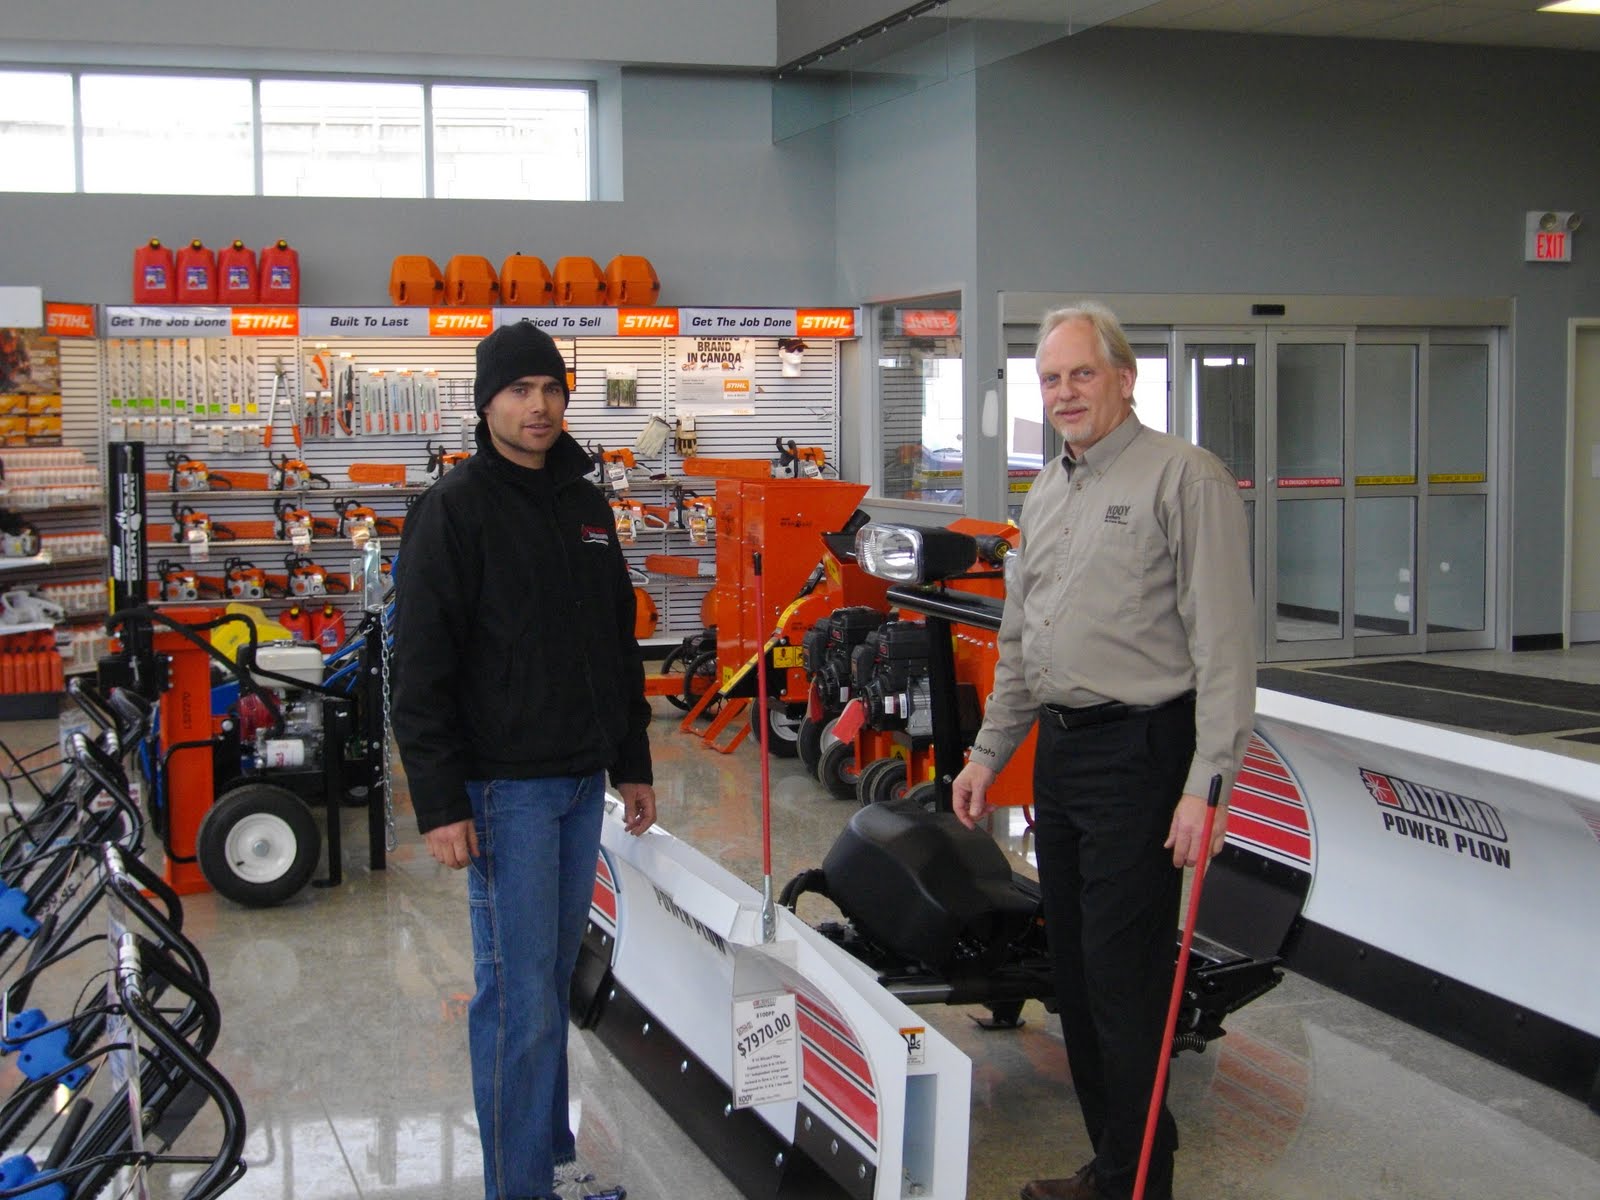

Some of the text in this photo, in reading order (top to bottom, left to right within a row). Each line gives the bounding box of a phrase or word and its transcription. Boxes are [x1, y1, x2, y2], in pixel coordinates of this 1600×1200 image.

[1537, 233, 1565, 259] EXIT
[48, 313, 90, 328] STIHL
[111, 316, 227, 327] Get The Job Done
[238, 314, 294, 329] STIHL
[330, 316, 409, 327] Built To Last
[435, 315, 488, 328] STIHL
[563, 317, 575, 327] To
[579, 317, 601, 327] Sell
[624, 315, 674, 328] STIHL
[692, 317, 792, 327] Get The Job Done
[801, 316, 850, 329] STIHL
[697, 341, 731, 352] BRAND
[687, 352, 742, 363] IN CANADA
[1387, 776, 1508, 842] BLIZZARD
[1382, 811, 1511, 869] POWER PLOW
[737, 1013, 791, 1059] $7970.00
